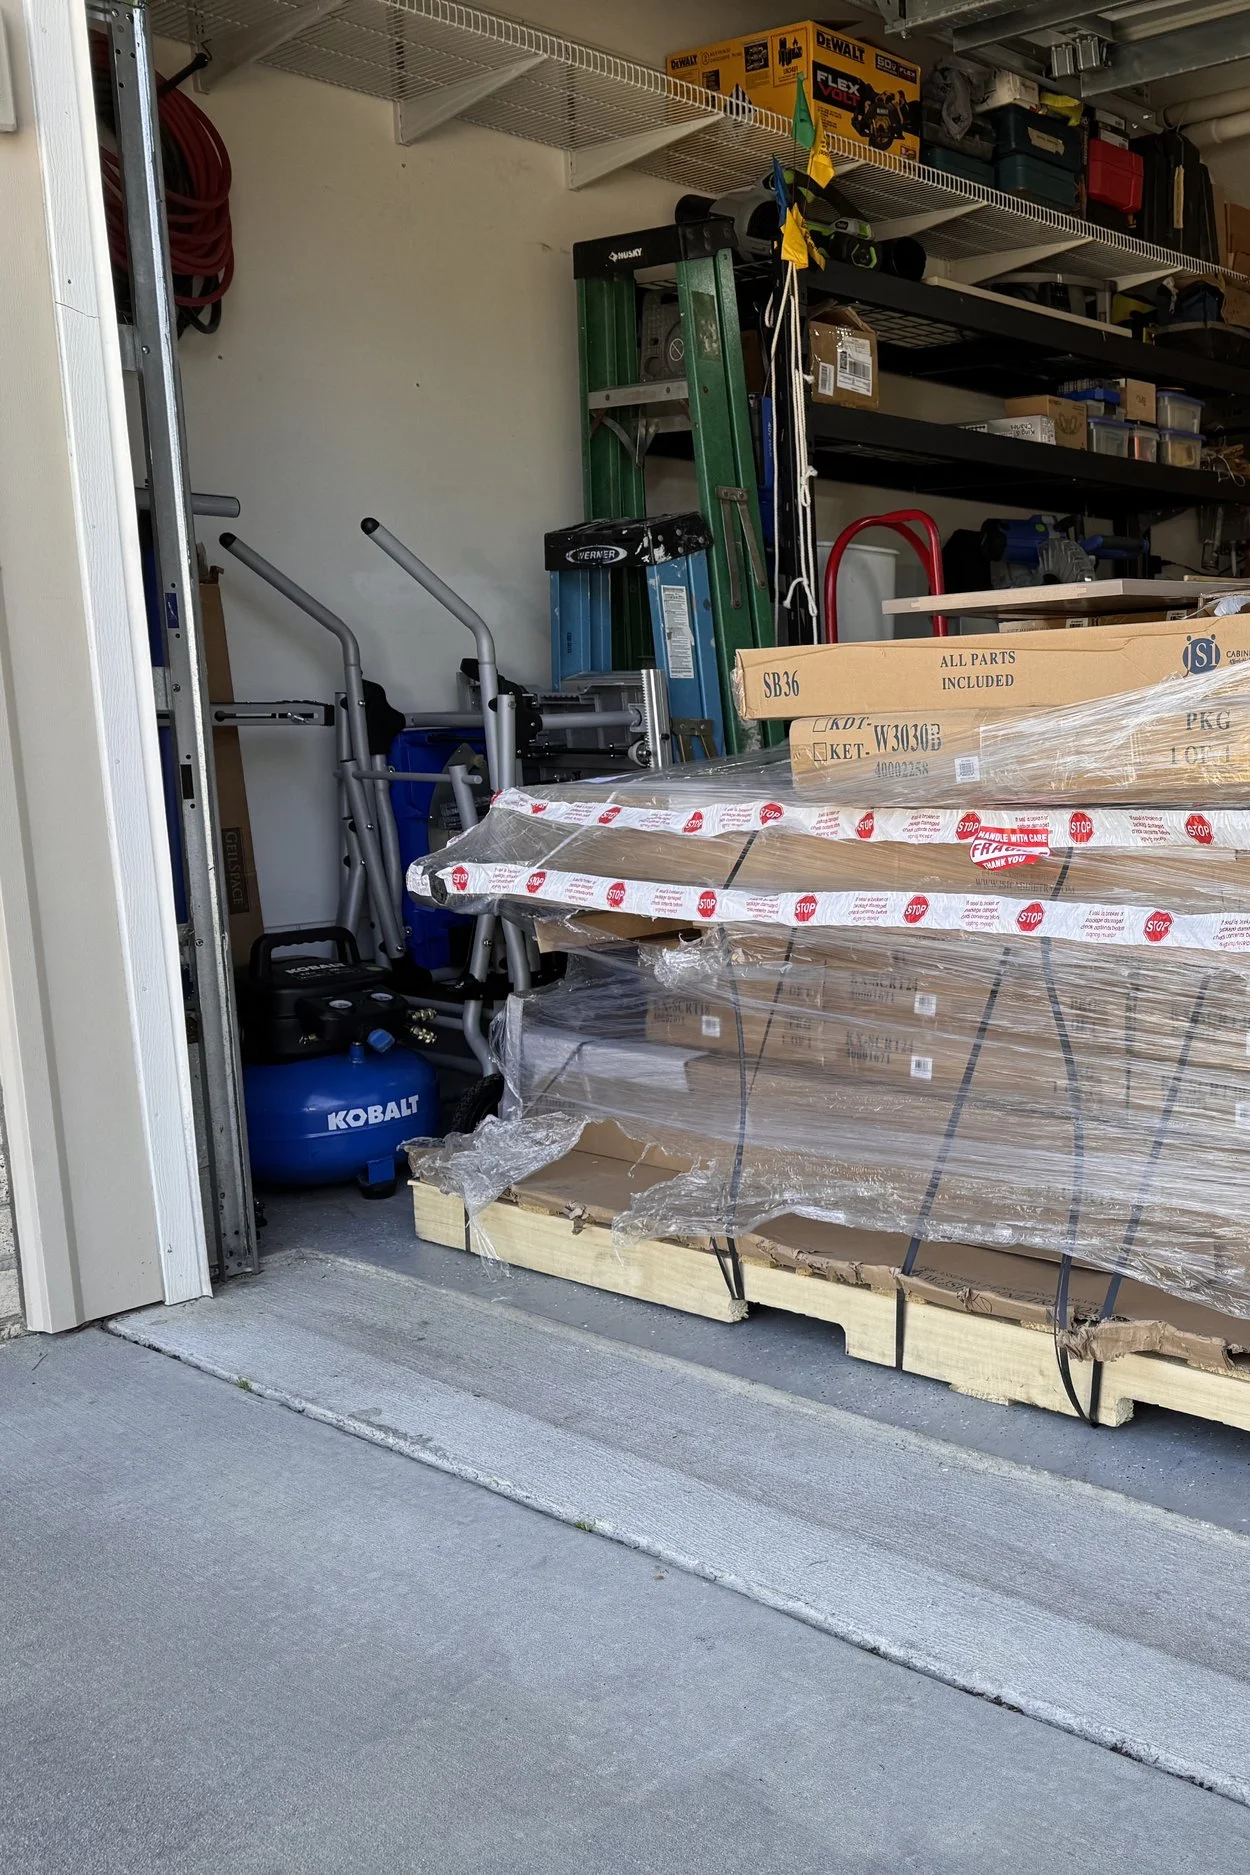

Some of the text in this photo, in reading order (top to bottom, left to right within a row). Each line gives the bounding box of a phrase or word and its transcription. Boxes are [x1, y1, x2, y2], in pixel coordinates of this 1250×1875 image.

[816, 69, 860, 97] FLEX
[818, 82, 860, 107] VOLT
[617, 248, 642, 260] HUSKY
[577, 550, 616, 561] WERNER
[941, 651, 1016, 668] ALL PARTS
[763, 671, 800, 699] SB36
[942, 674, 1014, 690] INCLUDED
[1186, 711, 1231, 731] PKG
[874, 723, 942, 753] W3030B
[830, 743, 870, 760] KET-
[1170, 747, 1177, 765] 1
[686, 819, 702, 829] STOP
[958, 821, 979, 833] STOP
[1071, 821, 1091, 833] STOP
[979, 831, 1047, 843] HANDLE WITH CARE
[1188, 825, 1211, 837] STOP
[983, 855, 1026, 870] THANK YOU
[453, 873, 467, 883] STOP
[608, 888, 625, 900] STOP
[699, 898, 717, 909] STOP
[797, 902, 817, 913] STOP
[906, 905, 927, 916] STOP
[1020, 912, 1041, 923] STOP
[1147, 920, 1170, 933] STOP
[285, 963, 346, 975] KOBALT
[328, 1094, 419, 1131] KOBALT
